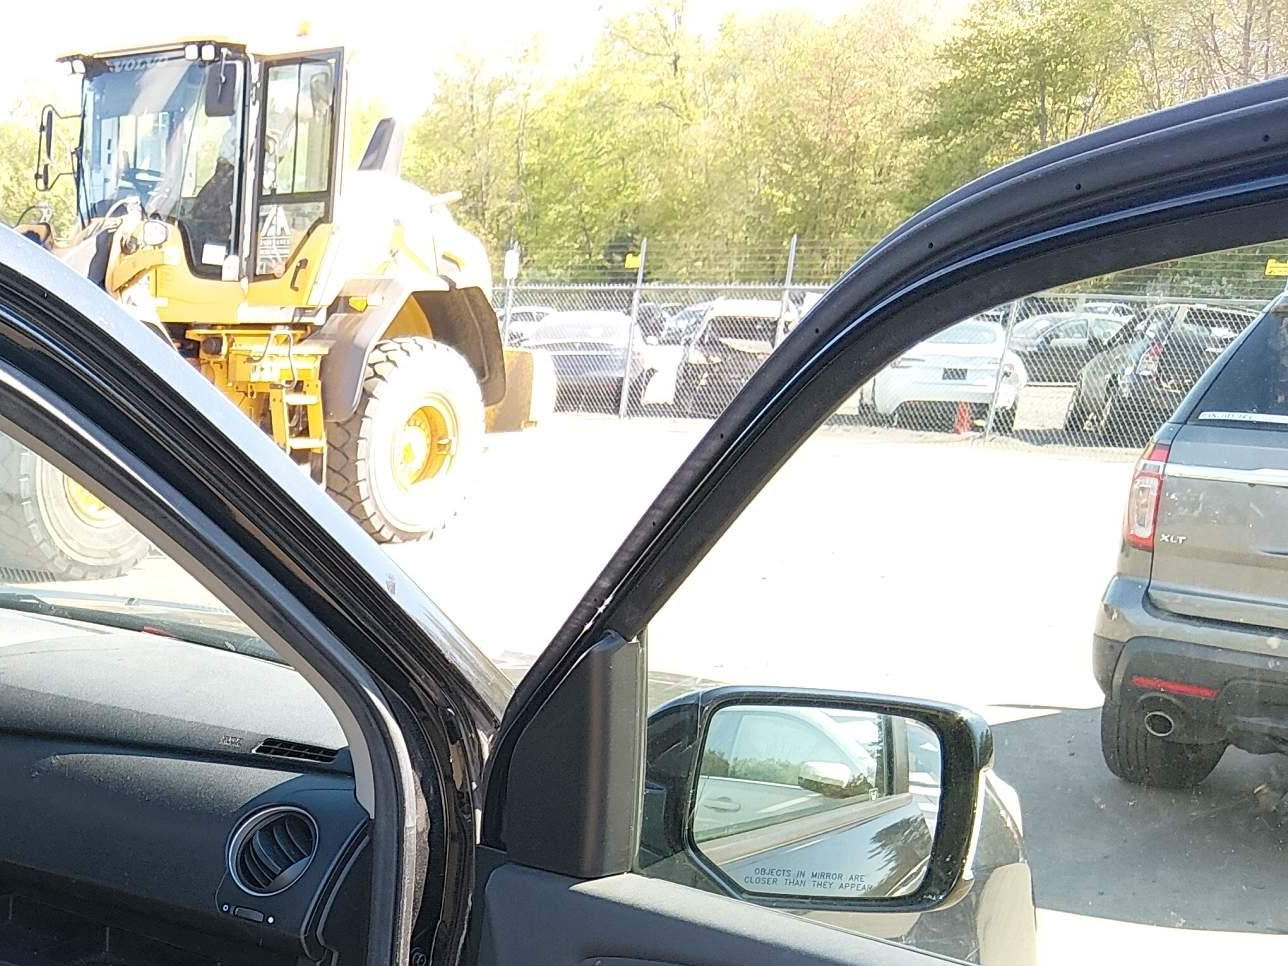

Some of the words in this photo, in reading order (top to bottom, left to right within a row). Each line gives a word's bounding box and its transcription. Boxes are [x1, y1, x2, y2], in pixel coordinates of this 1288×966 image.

[1159, 533, 1187, 545] XLT
[754, 867, 791, 878] OBJECTS
[796, 870, 806, 878] IN
[811, 871, 843, 881] MIRROR
[848, 874, 865, 882] ARE
[744, 876, 778, 886] CLOSER
[784, 878, 806, 888] THAN
[812, 879, 833, 889] THEY
[838, 882, 873, 892] APPEAR
